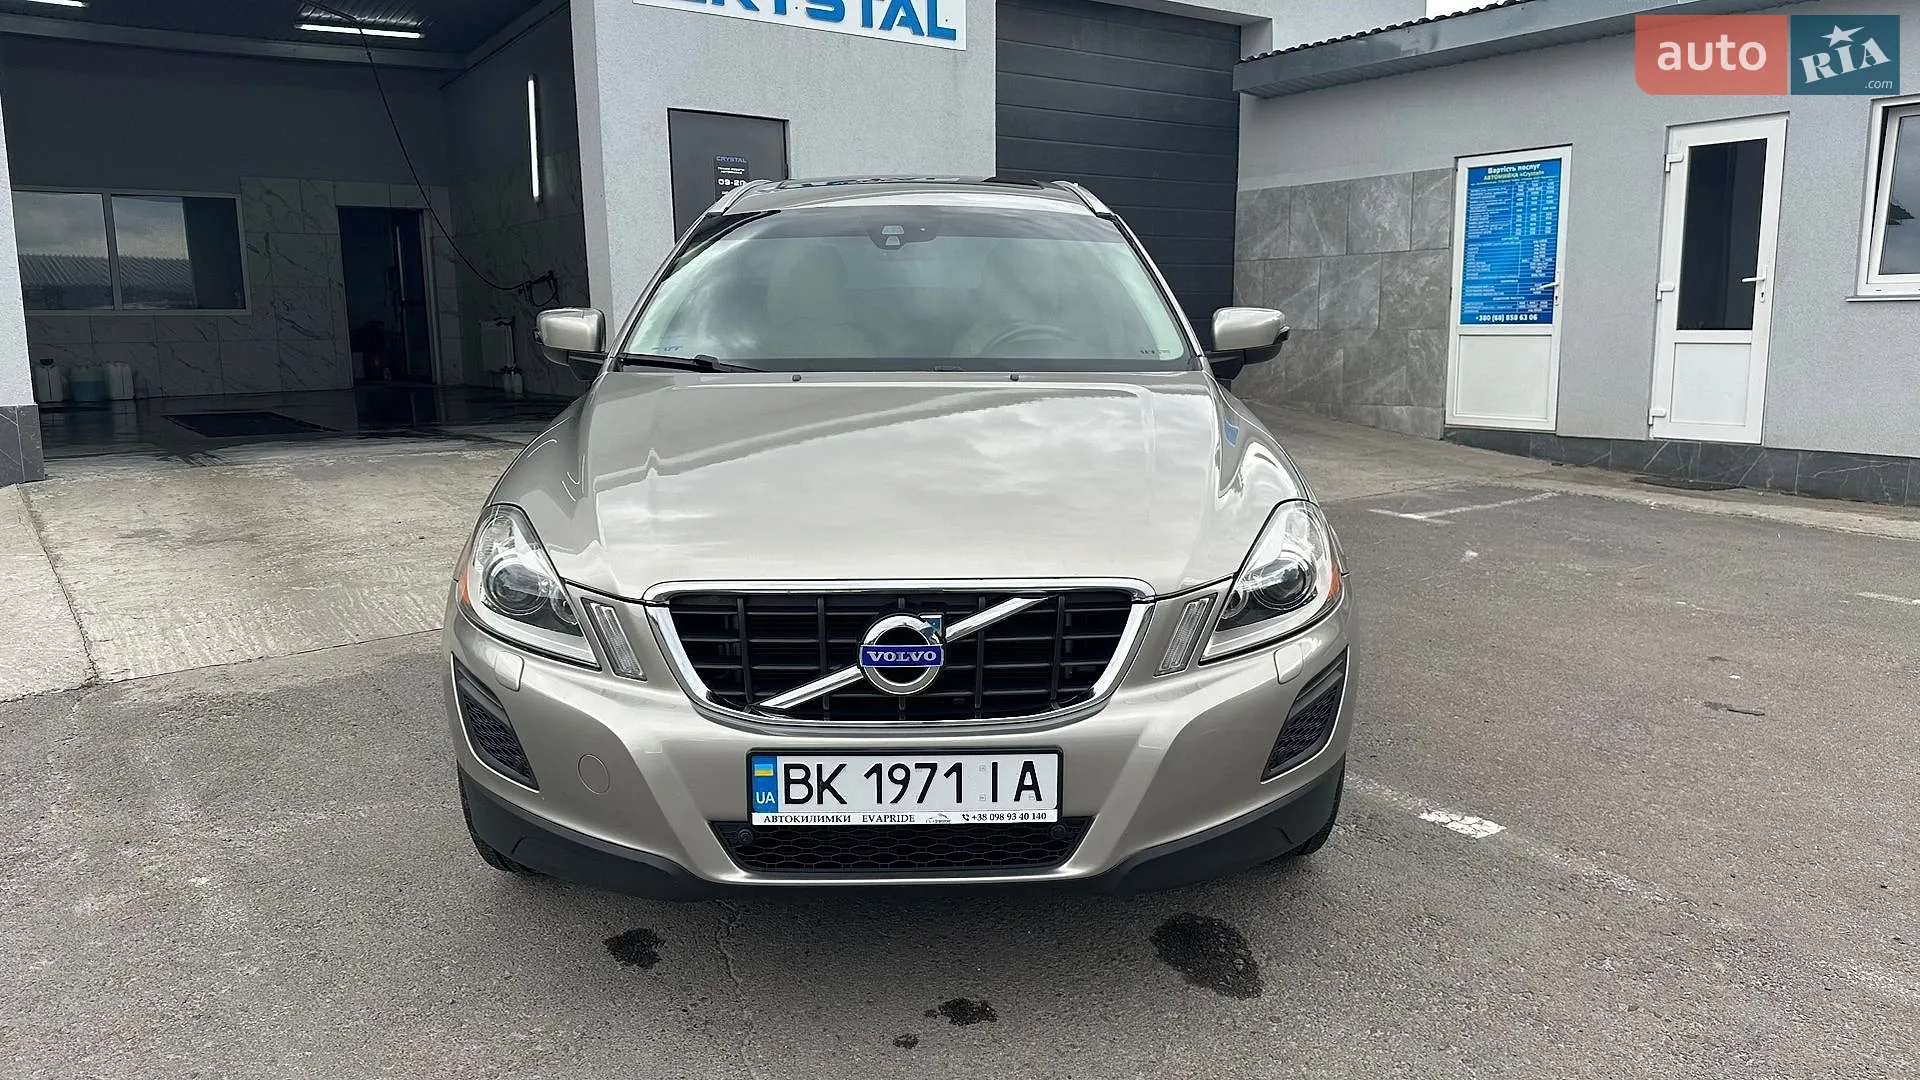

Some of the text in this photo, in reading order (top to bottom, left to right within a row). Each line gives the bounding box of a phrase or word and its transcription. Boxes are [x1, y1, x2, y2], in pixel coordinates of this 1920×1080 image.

[683, 0, 956, 40] STAL
[1487, 164, 1541, 174] Вартість послуг
[867, 651, 937, 662] VOLVO
[784, 761, 1042, 804] BK 1971 IA
[756, 792, 775, 804] UA
[764, 814, 915, 823] АВТОКИЛИМКИ EVAPRIDE
[990, 813, 1004, 821] 098
[1007, 813, 1017, 821] 93
[1032, 812, 1047, 820] 140
